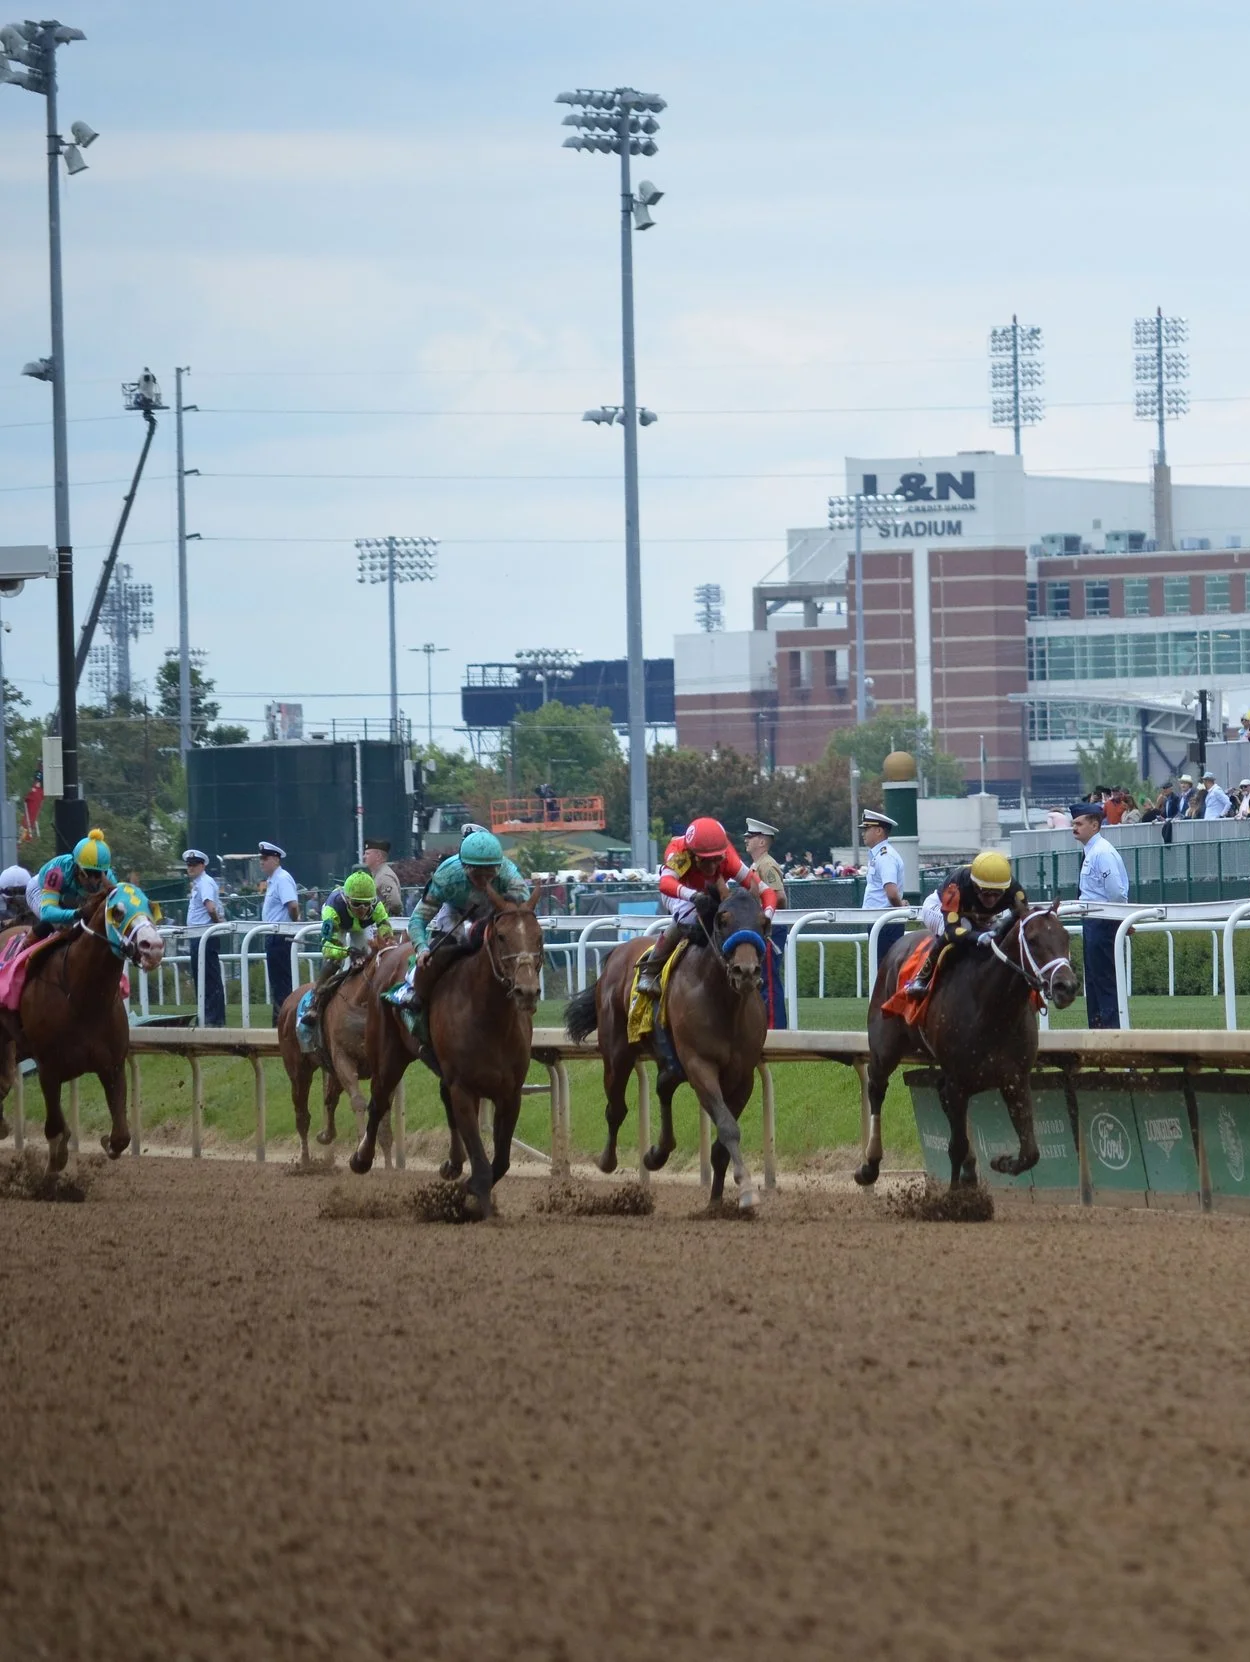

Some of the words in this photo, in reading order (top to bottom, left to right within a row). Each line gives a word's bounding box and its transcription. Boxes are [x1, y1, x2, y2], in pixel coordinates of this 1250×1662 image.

[944, 503, 976, 512] UNION
[879, 520, 962, 538] STADIUM
[1145, 1117, 1183, 1140] LONGINES
[1099, 1120, 1125, 1161] Ford
